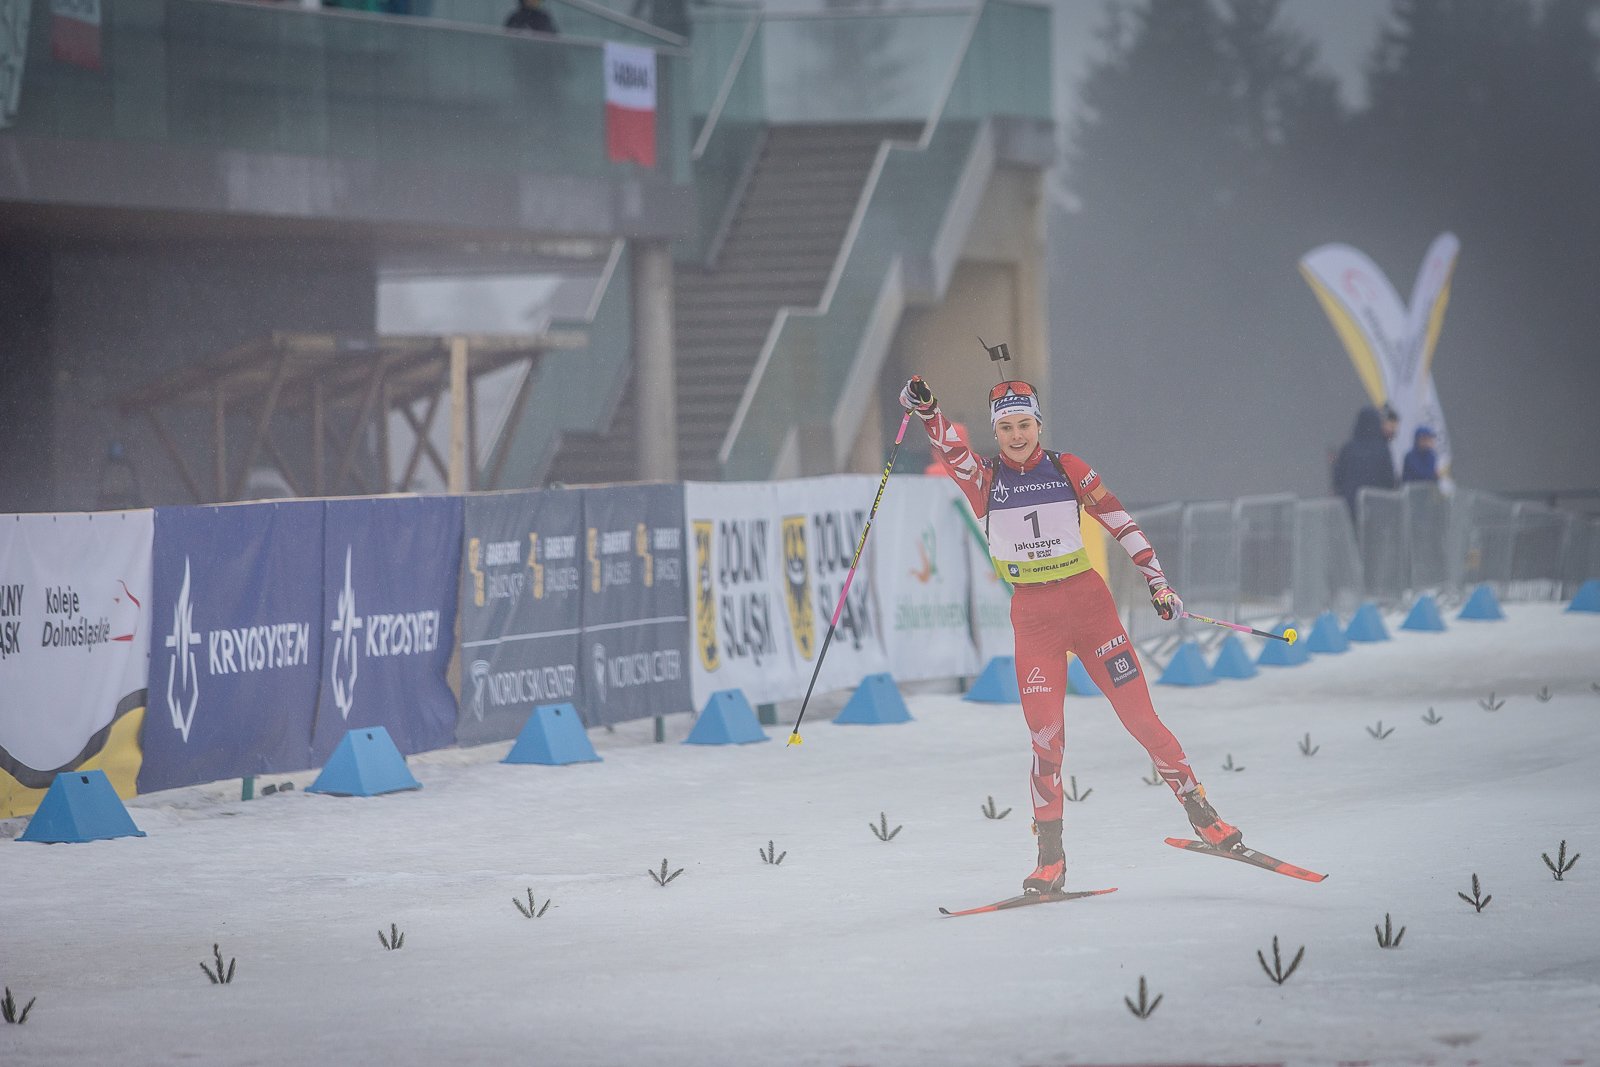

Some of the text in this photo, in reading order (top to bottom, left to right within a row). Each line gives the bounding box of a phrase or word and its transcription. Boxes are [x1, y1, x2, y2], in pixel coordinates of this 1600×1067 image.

[1023, 510, 1041, 539] 1
[1014, 538, 1062, 553] Jakuszyce
[1032, 564, 1059, 573] OFFICIAL
[0, 584, 24, 617] LNY
[45, 585, 80, 620] Koleje
[1113, 667, 1138, 683] Husqvarna
